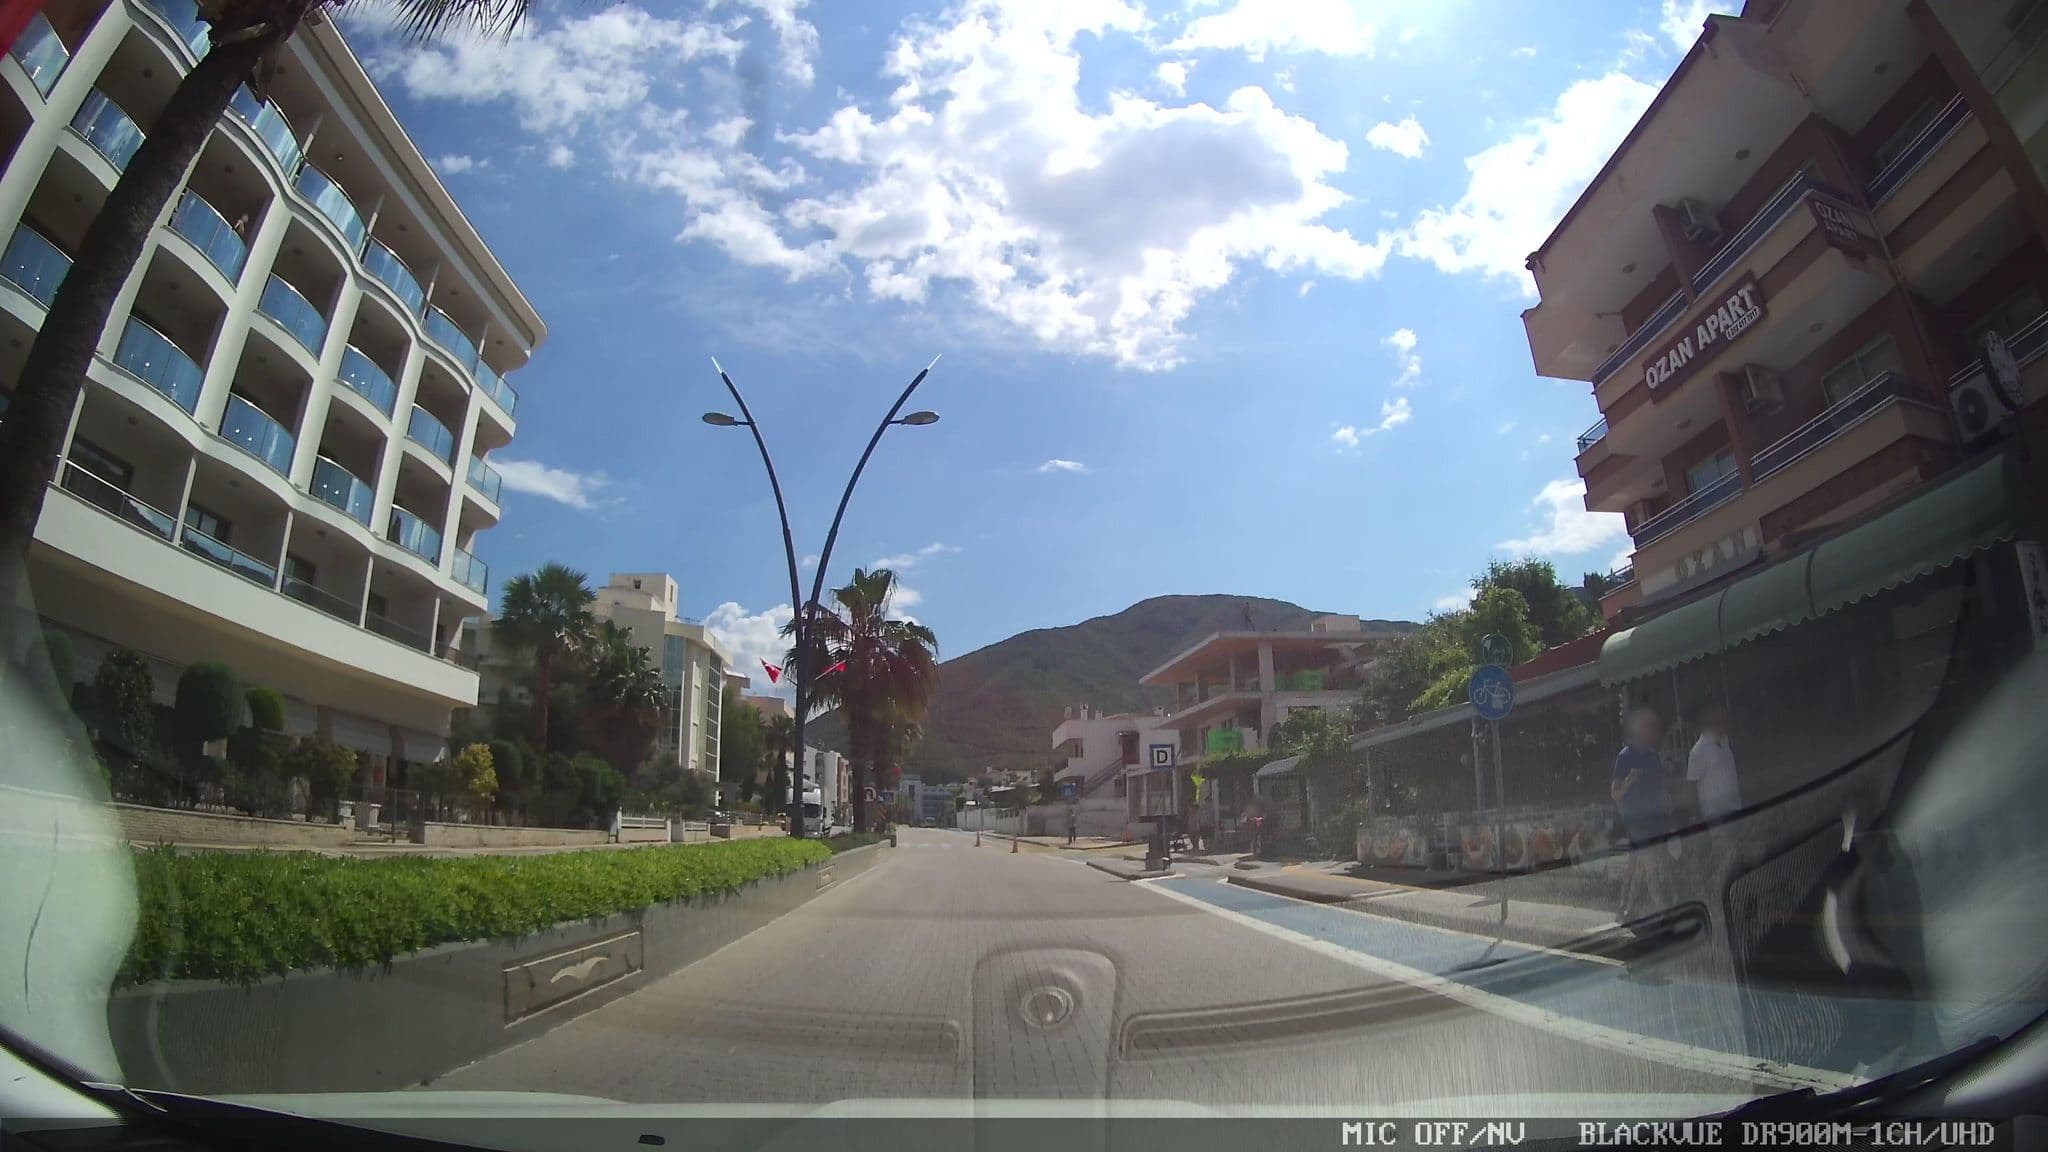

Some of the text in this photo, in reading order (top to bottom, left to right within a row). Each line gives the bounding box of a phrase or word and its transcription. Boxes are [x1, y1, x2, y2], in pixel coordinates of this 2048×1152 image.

[1645, 282, 1755, 389] OZAN APART
[1156, 749, 1168, 763] D
